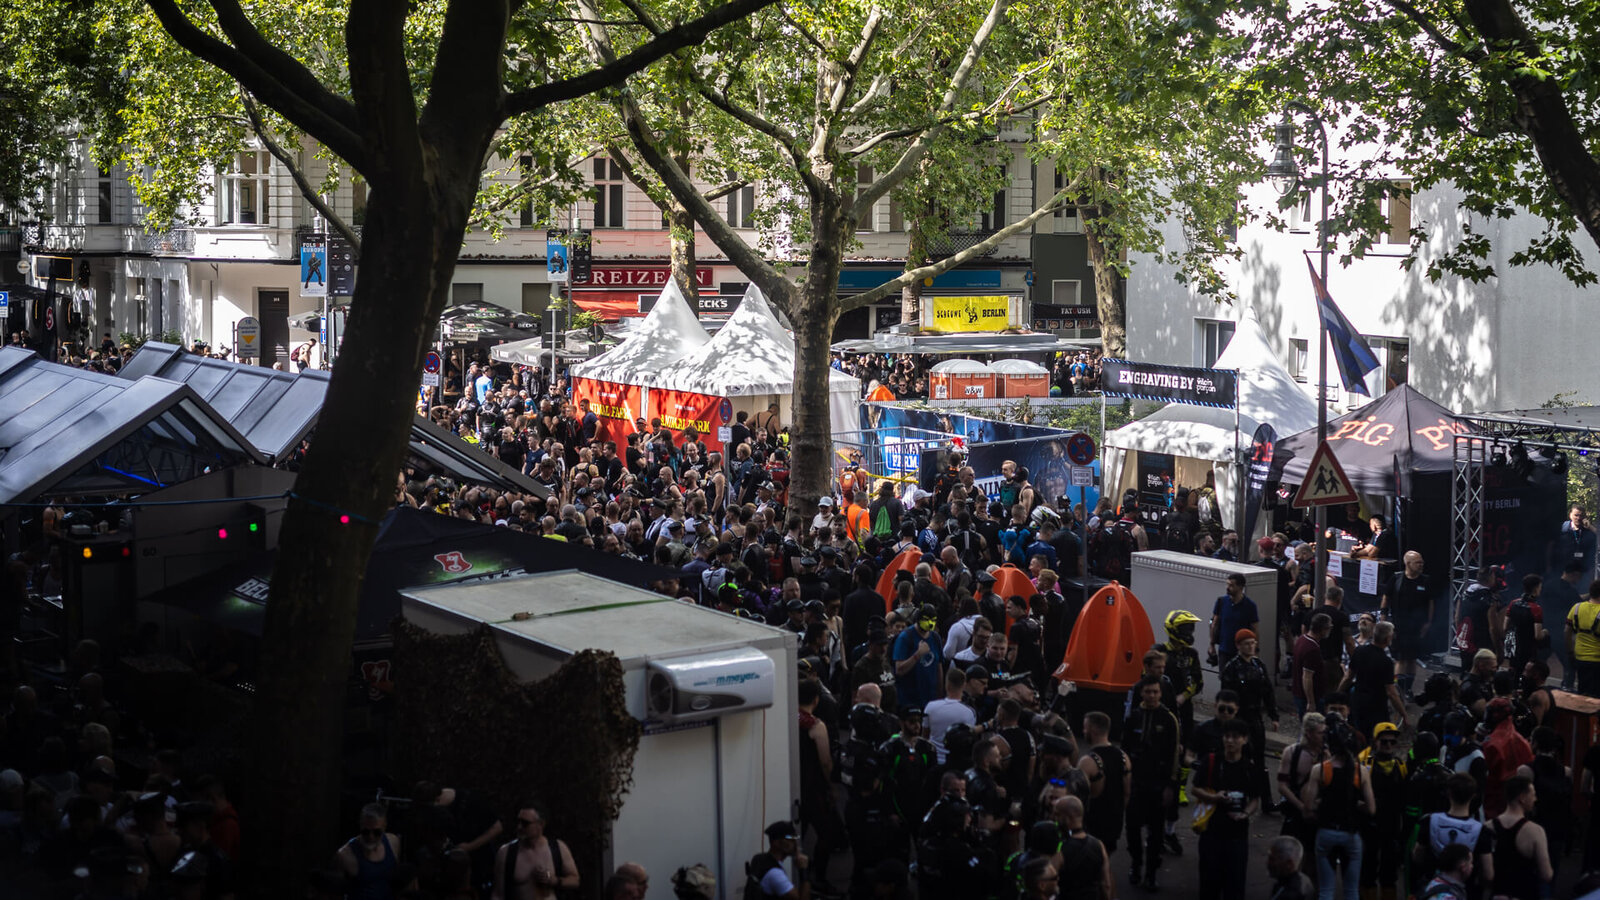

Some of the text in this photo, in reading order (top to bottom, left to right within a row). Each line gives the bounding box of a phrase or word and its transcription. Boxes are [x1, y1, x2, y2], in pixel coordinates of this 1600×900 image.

[698, 299, 729, 309] ECK'S
[982, 308, 1006, 318] BERLIN
[1118, 370, 1195, 390] ENGRAVING BY
[660, 413, 686, 431] ANIMAL
[1495, 498, 1521, 510] BERLIN
